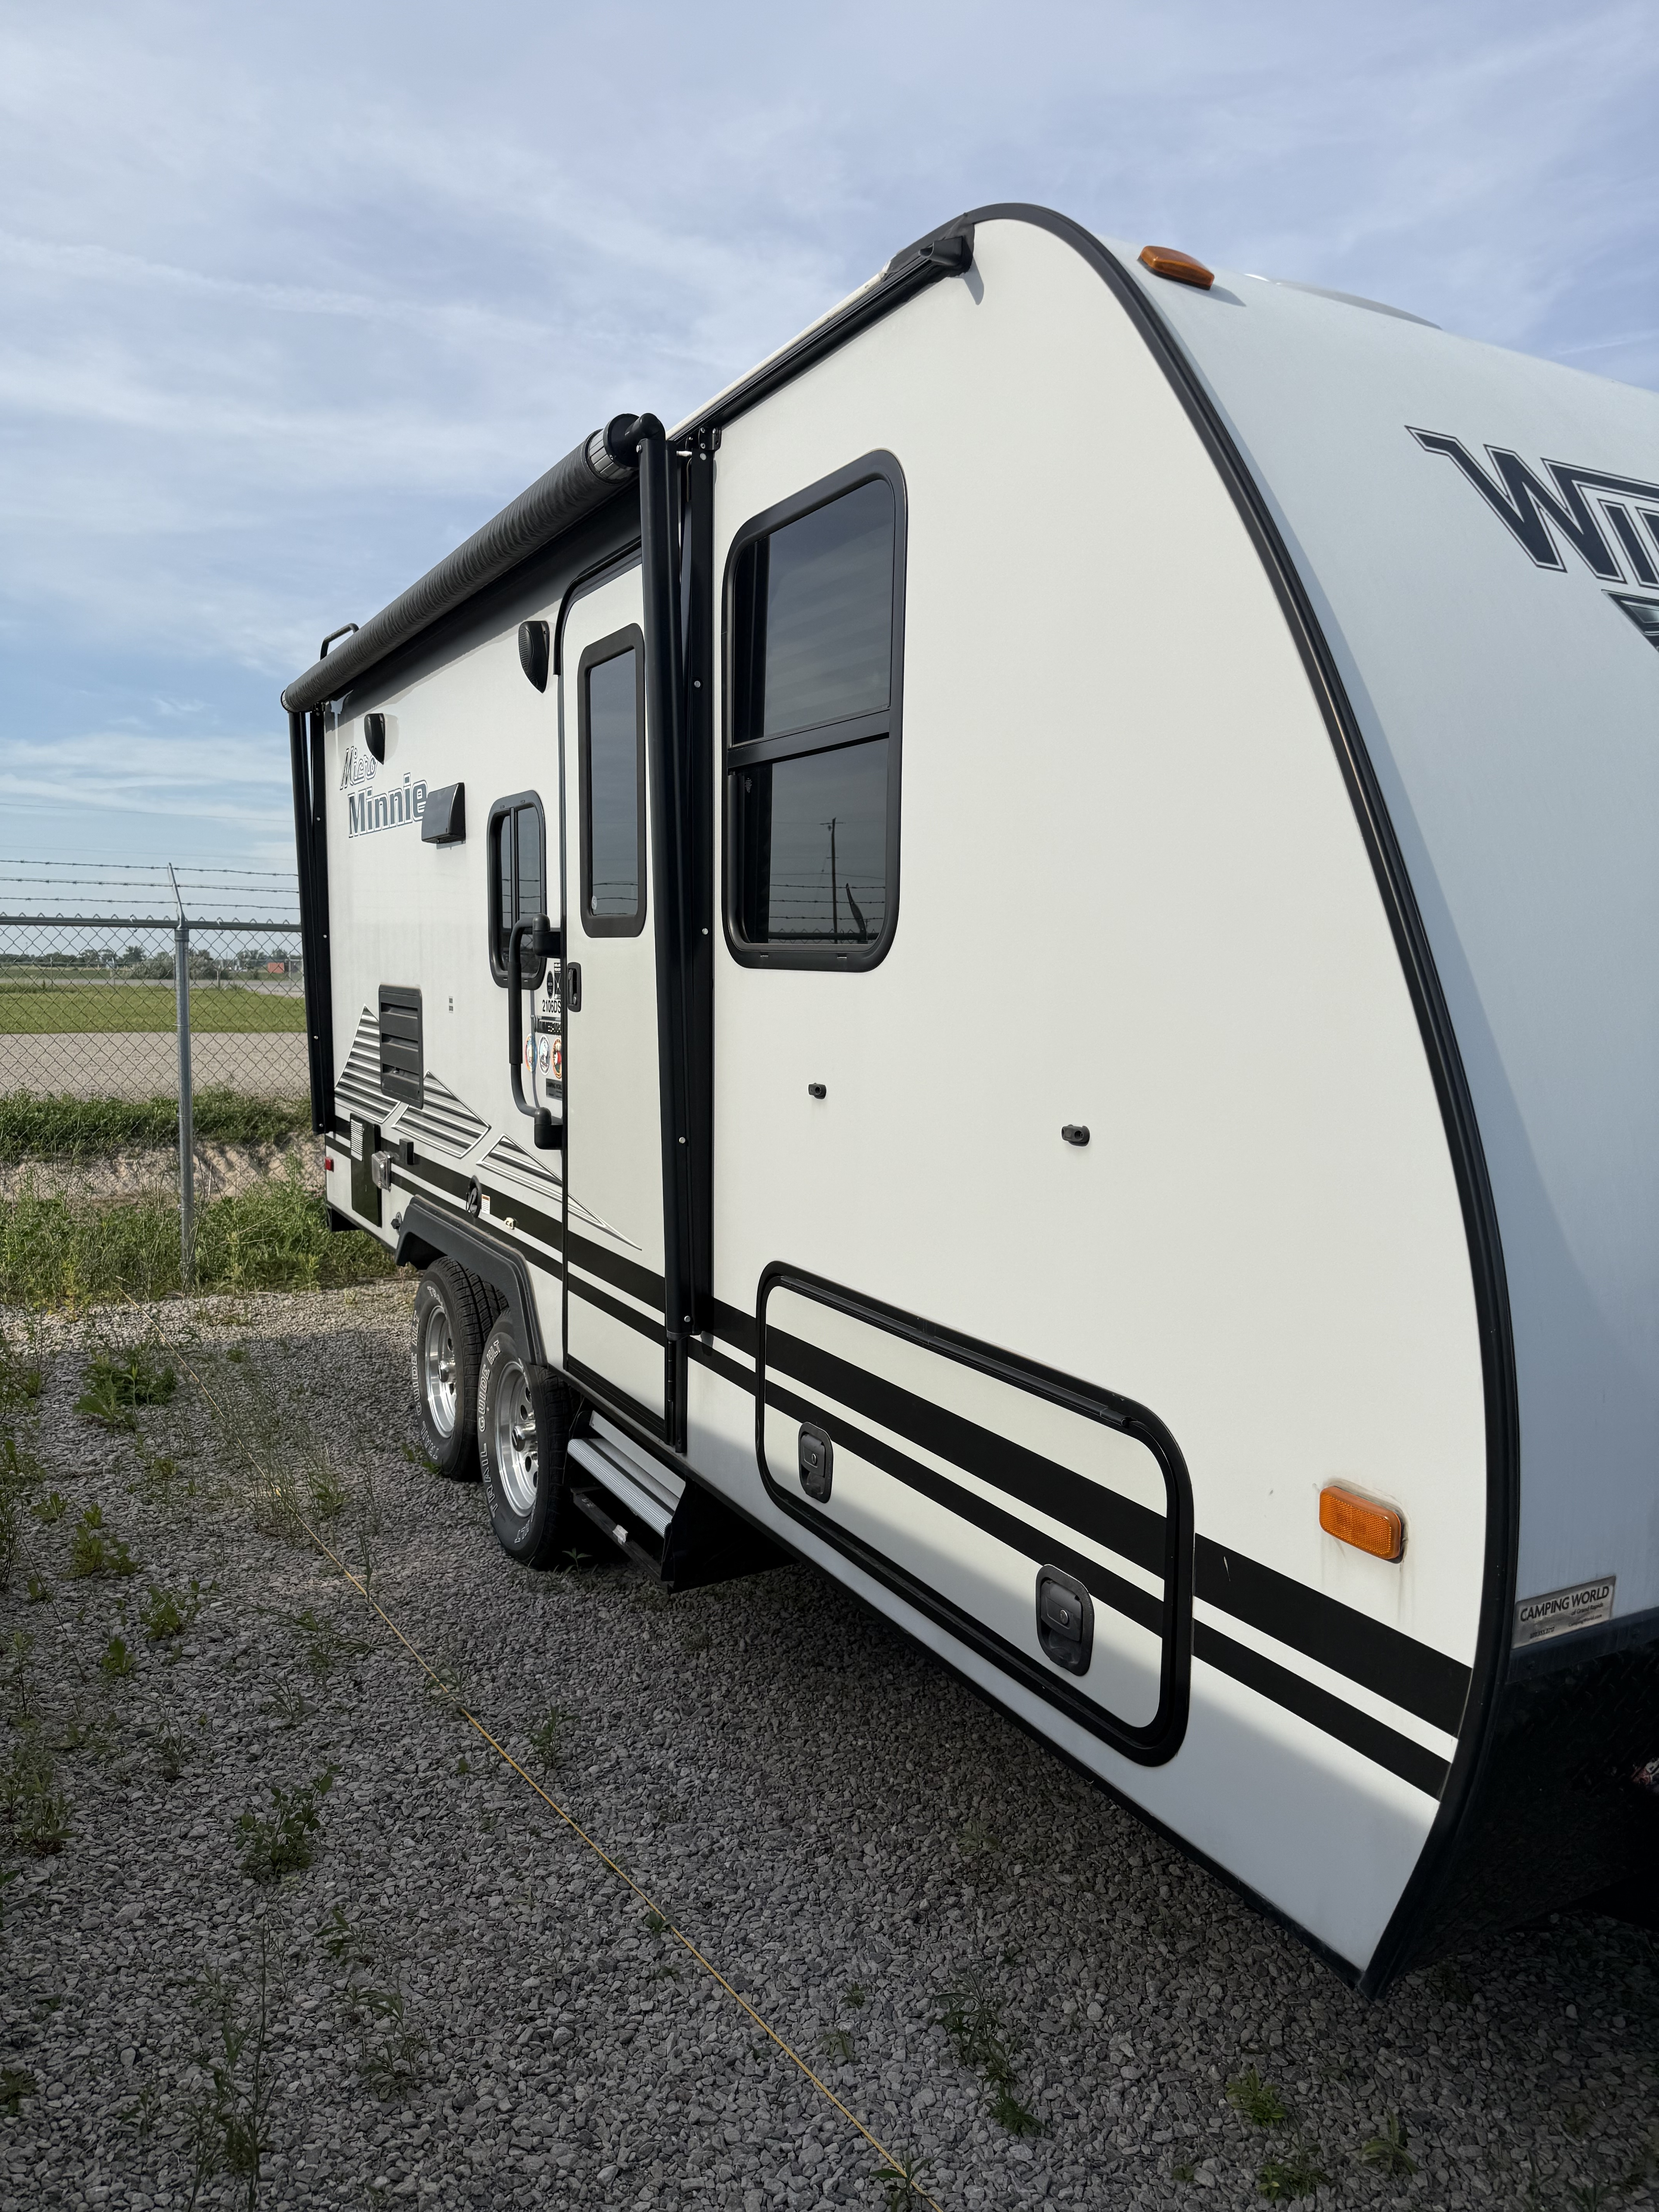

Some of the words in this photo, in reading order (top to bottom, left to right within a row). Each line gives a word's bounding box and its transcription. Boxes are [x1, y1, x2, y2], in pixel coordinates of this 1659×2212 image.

[340, 746, 378, 790] Micro
[348, 772, 428, 838] Minnie
[542, 1000, 561, 1013] 2106DS
[412, 1310, 421, 1346] HLT
[486, 1340, 501, 1365] HLT
[411, 1353, 422, 1416] GUIDE
[479, 1364, 490, 1432] GUIDE
[421, 1421, 439, 1460] TRAIL
[480, 1443, 498, 1518] TRAIL
[1520, 1596, 1569, 1621] CAMPING
[1571, 1586, 1609, 1607] WORLD
[1577, 1605, 1590, 1614] Grand
